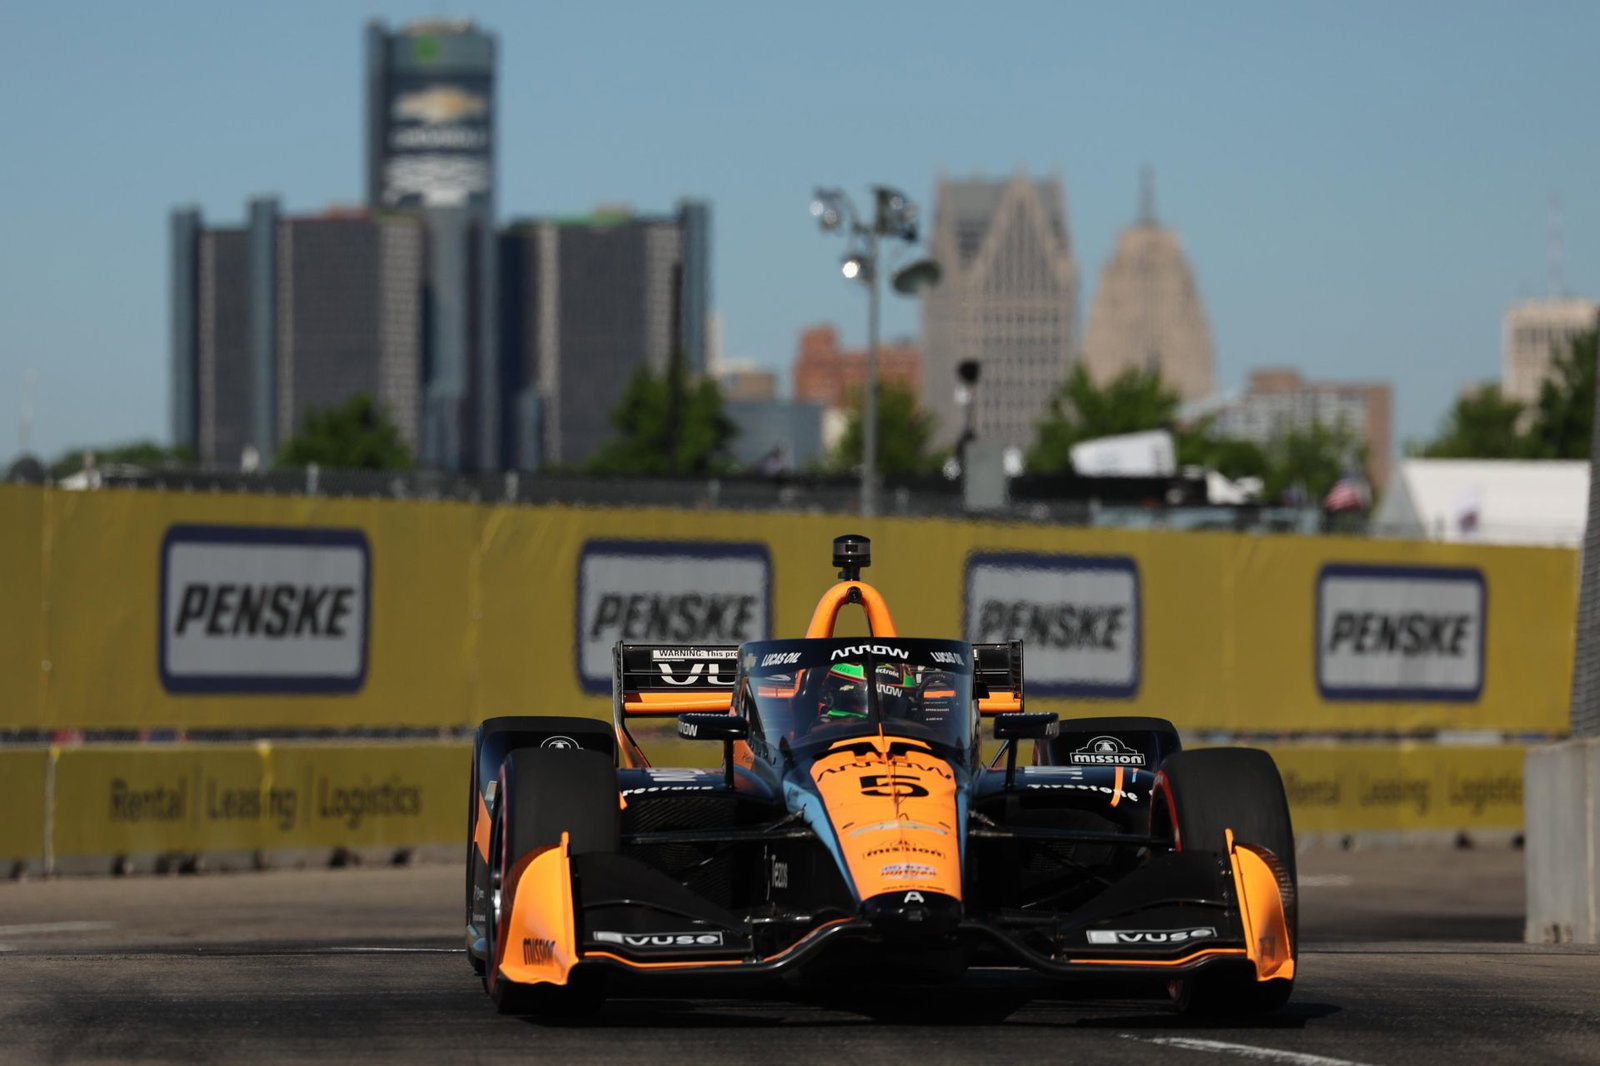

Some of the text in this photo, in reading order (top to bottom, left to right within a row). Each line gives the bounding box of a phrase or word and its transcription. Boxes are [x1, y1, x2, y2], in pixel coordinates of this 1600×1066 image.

[175, 582, 355, 638] PENSKE
[591, 592, 755, 641] PENSKE
[978, 600, 1126, 649] PENSKE
[1329, 611, 1470, 657] PENSKE
[659, 650, 705, 658] WARNING:
[706, 650, 724, 658] This
[761, 652, 802, 667] LUCAS OIL
[830, 645, 909, 661] ARROW
[658, 663, 736, 685] VU
[1073, 754, 1142, 764] mission
[622, 786, 714, 797] restone
[859, 774, 930, 798] 5
[110, 778, 185, 821] Rental
[319, 777, 422, 828] Logistics
